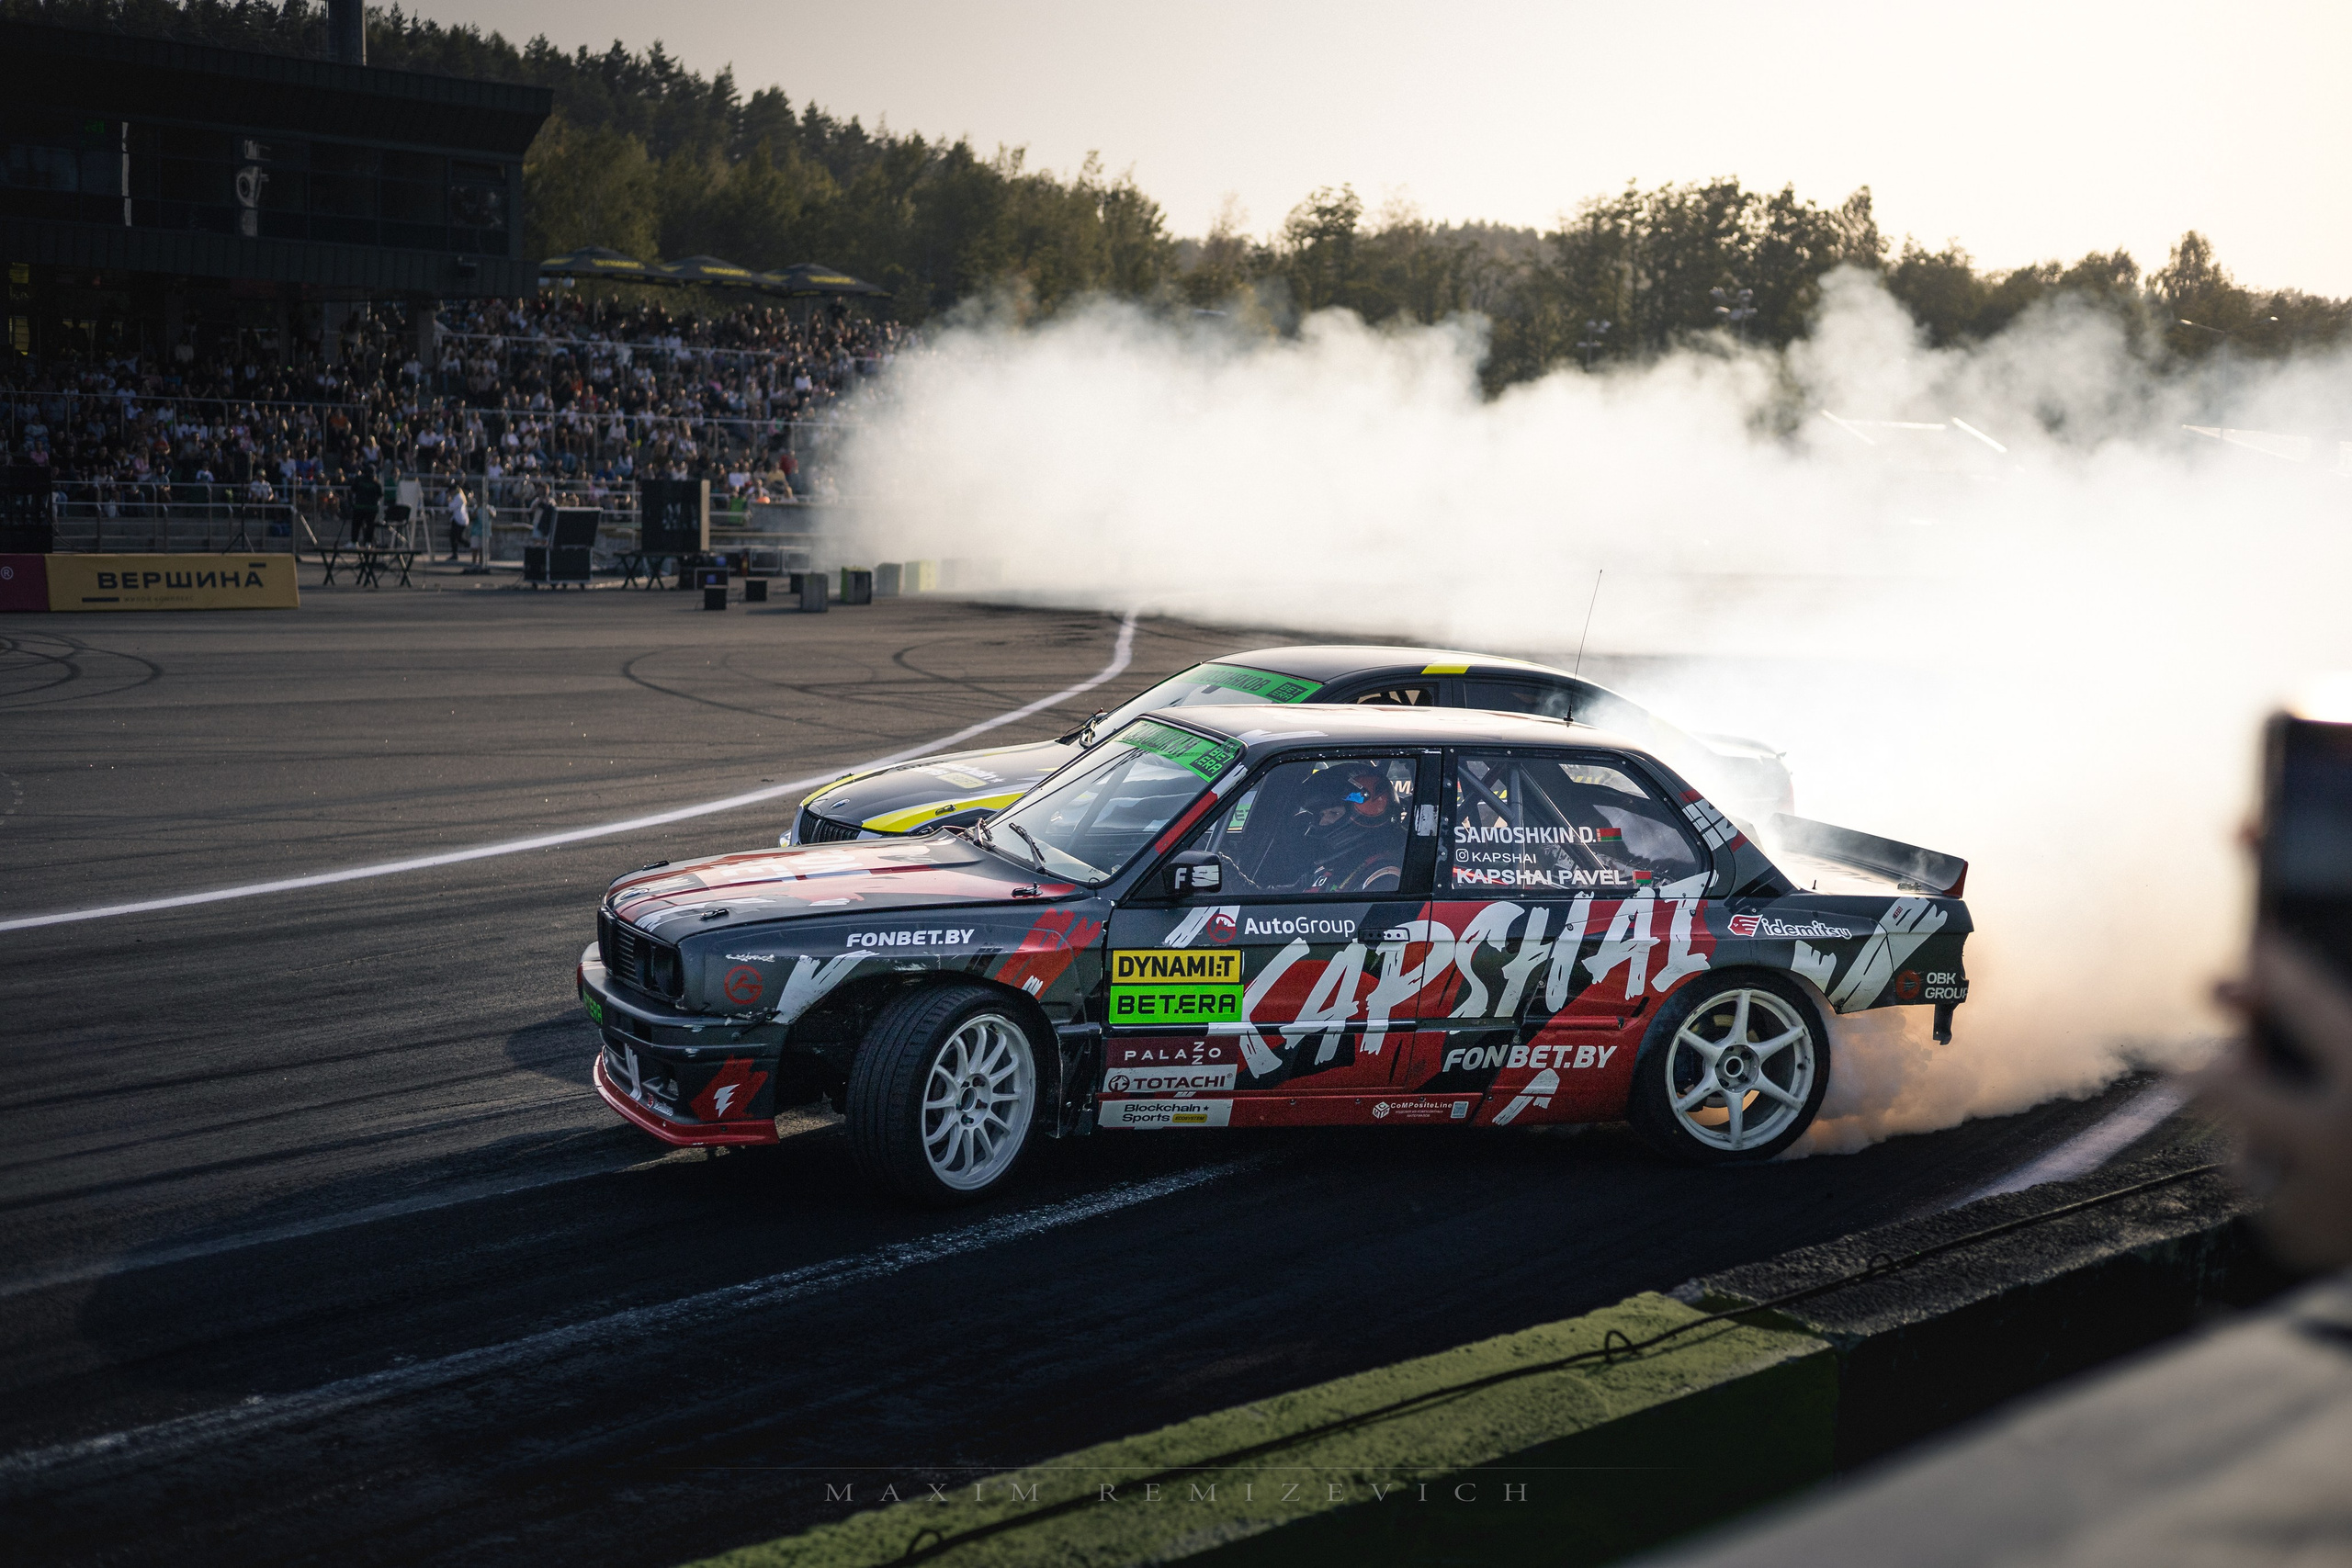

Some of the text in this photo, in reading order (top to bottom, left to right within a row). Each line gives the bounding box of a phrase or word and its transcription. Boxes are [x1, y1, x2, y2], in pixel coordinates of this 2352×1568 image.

[1453, 826, 1597, 844] SAMOSHKIN D.
[1472, 852, 1537, 864] KAPSHAI
[1456, 868, 1627, 886] KAPSHAI PAVEL
[1244, 916, 1356, 937] AutoGroup
[1760, 918, 1853, 941] idemitsu
[846, 929, 975, 948] FONBET.BY
[1926, 972, 1957, 985] OBK
[1442, 1044, 1618, 1073] FONBET.BY
[1124, 1103, 1201, 1112] Blockchain
[1122, 1112, 1170, 1123] Sports
